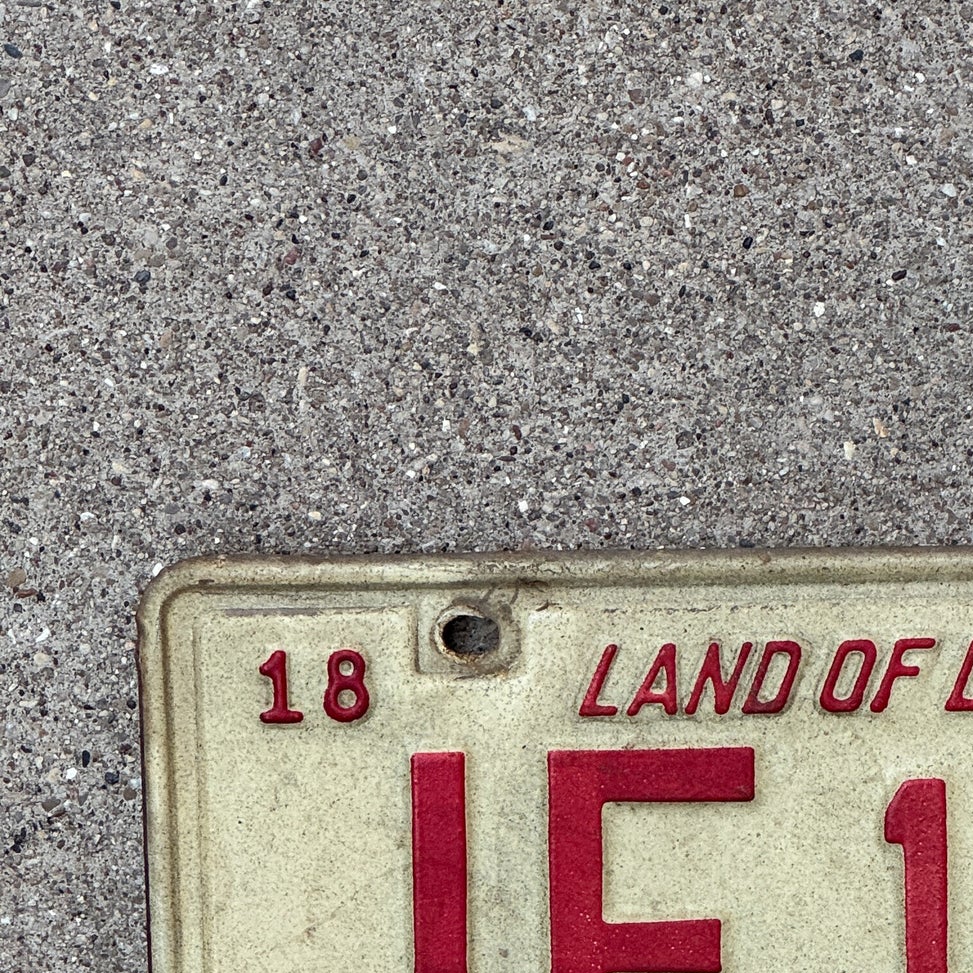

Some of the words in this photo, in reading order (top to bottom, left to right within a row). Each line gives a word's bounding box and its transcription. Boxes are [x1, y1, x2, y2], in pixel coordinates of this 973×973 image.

[258, 649, 370, 725] 18
[579, 641, 802, 718] LAND
[819, 637, 937, 714] OF
